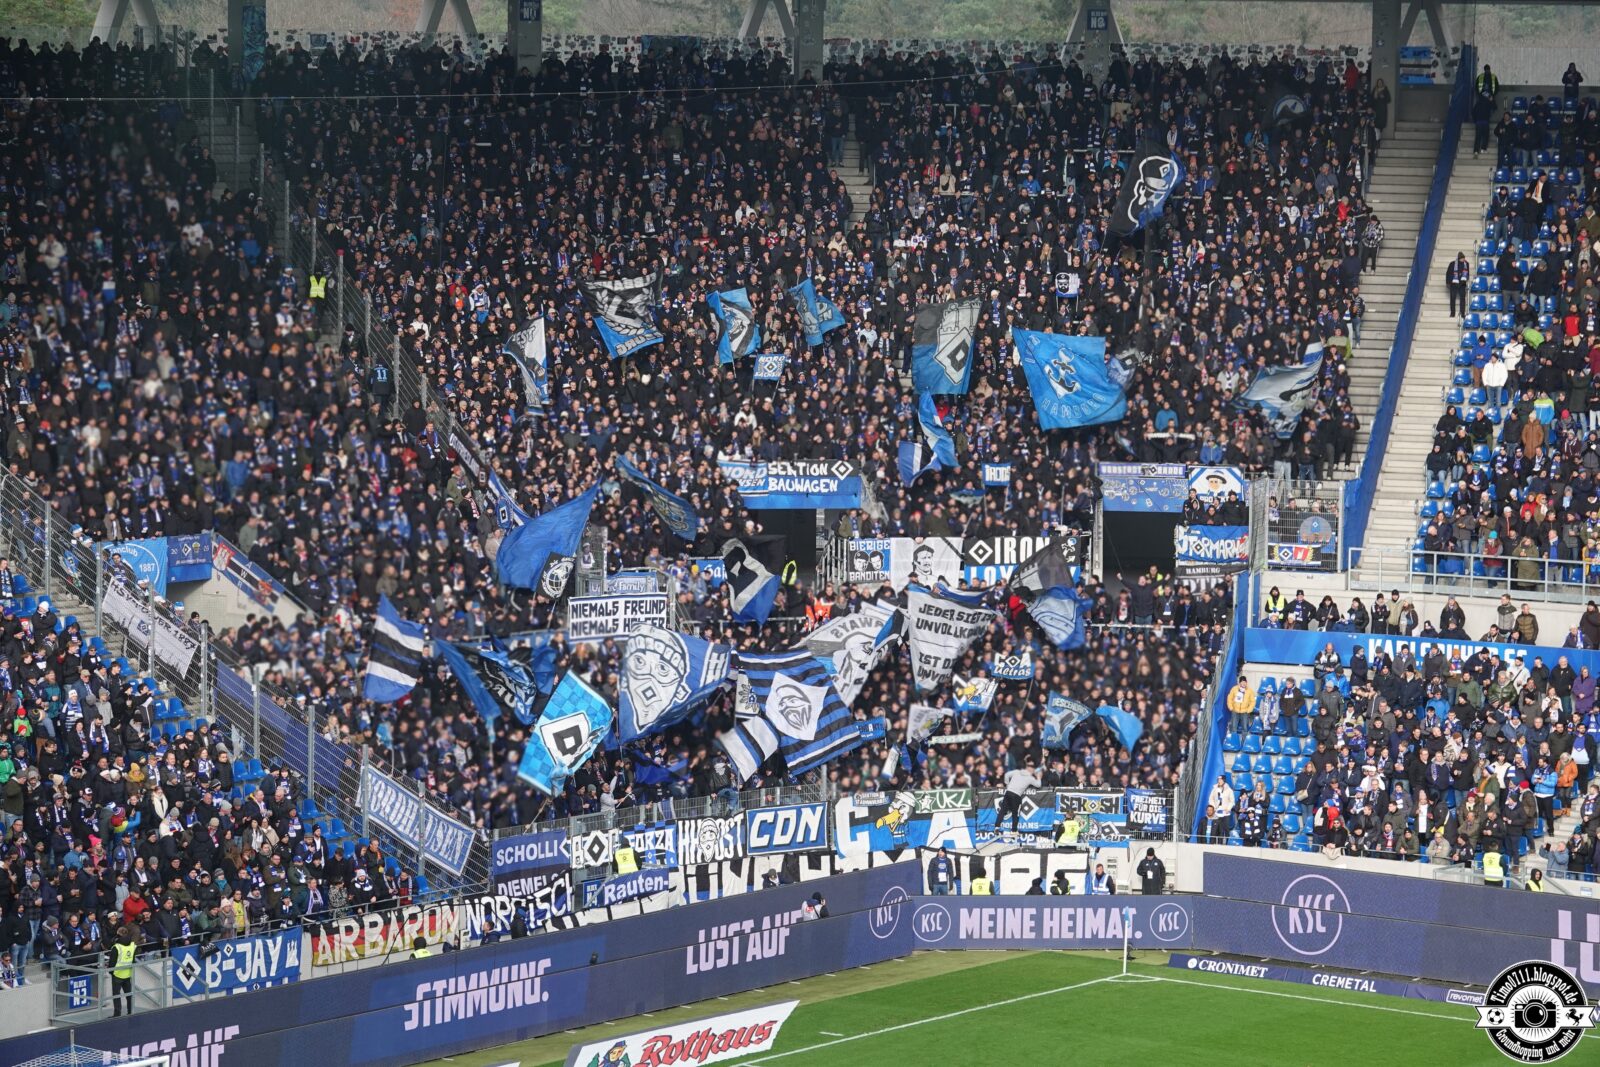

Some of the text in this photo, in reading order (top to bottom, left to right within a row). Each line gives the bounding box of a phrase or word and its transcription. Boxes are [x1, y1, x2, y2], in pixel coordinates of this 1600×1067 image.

[768, 479, 839, 493] BAUWAGEN
[850, 540, 891, 551] BIERIGE
[619, 580, 645, 593] Family
[850, 571, 890, 581] BANDITEN
[571, 600, 666, 619] NIEMALS FREUND
[919, 604, 955, 621] JEDER
[571, 618, 619, 637] NIEMALS
[919, 652, 941, 668] IST
[1130, 795, 1166, 805] FREIHEIT
[1134, 802, 1162, 813] FÜR DIE
[750, 806, 824, 849] CDN
[1130, 811, 1166, 825] KURVE
[624, 829, 675, 854] FORZA
[496, 839, 558, 867] SCHOLLI
[604, 874, 669, 906] Rauten-
[921, 911, 942, 933] KSC
[959, 907, 1142, 940] MEINE HEIMAT.
[1158, 911, 1180, 932] KSC
[1289, 893, 1336, 934] KSC
[364, 903, 460, 958] BARON
[686, 910, 803, 976] LUST AUF
[1199, 958, 1377, 993] CRONIMET CREMETAL
[404, 958, 551, 1031] STIMMUNG.
[1449, 992, 1483, 1004] revomet
[640, 1020, 778, 1067] Rothaus
